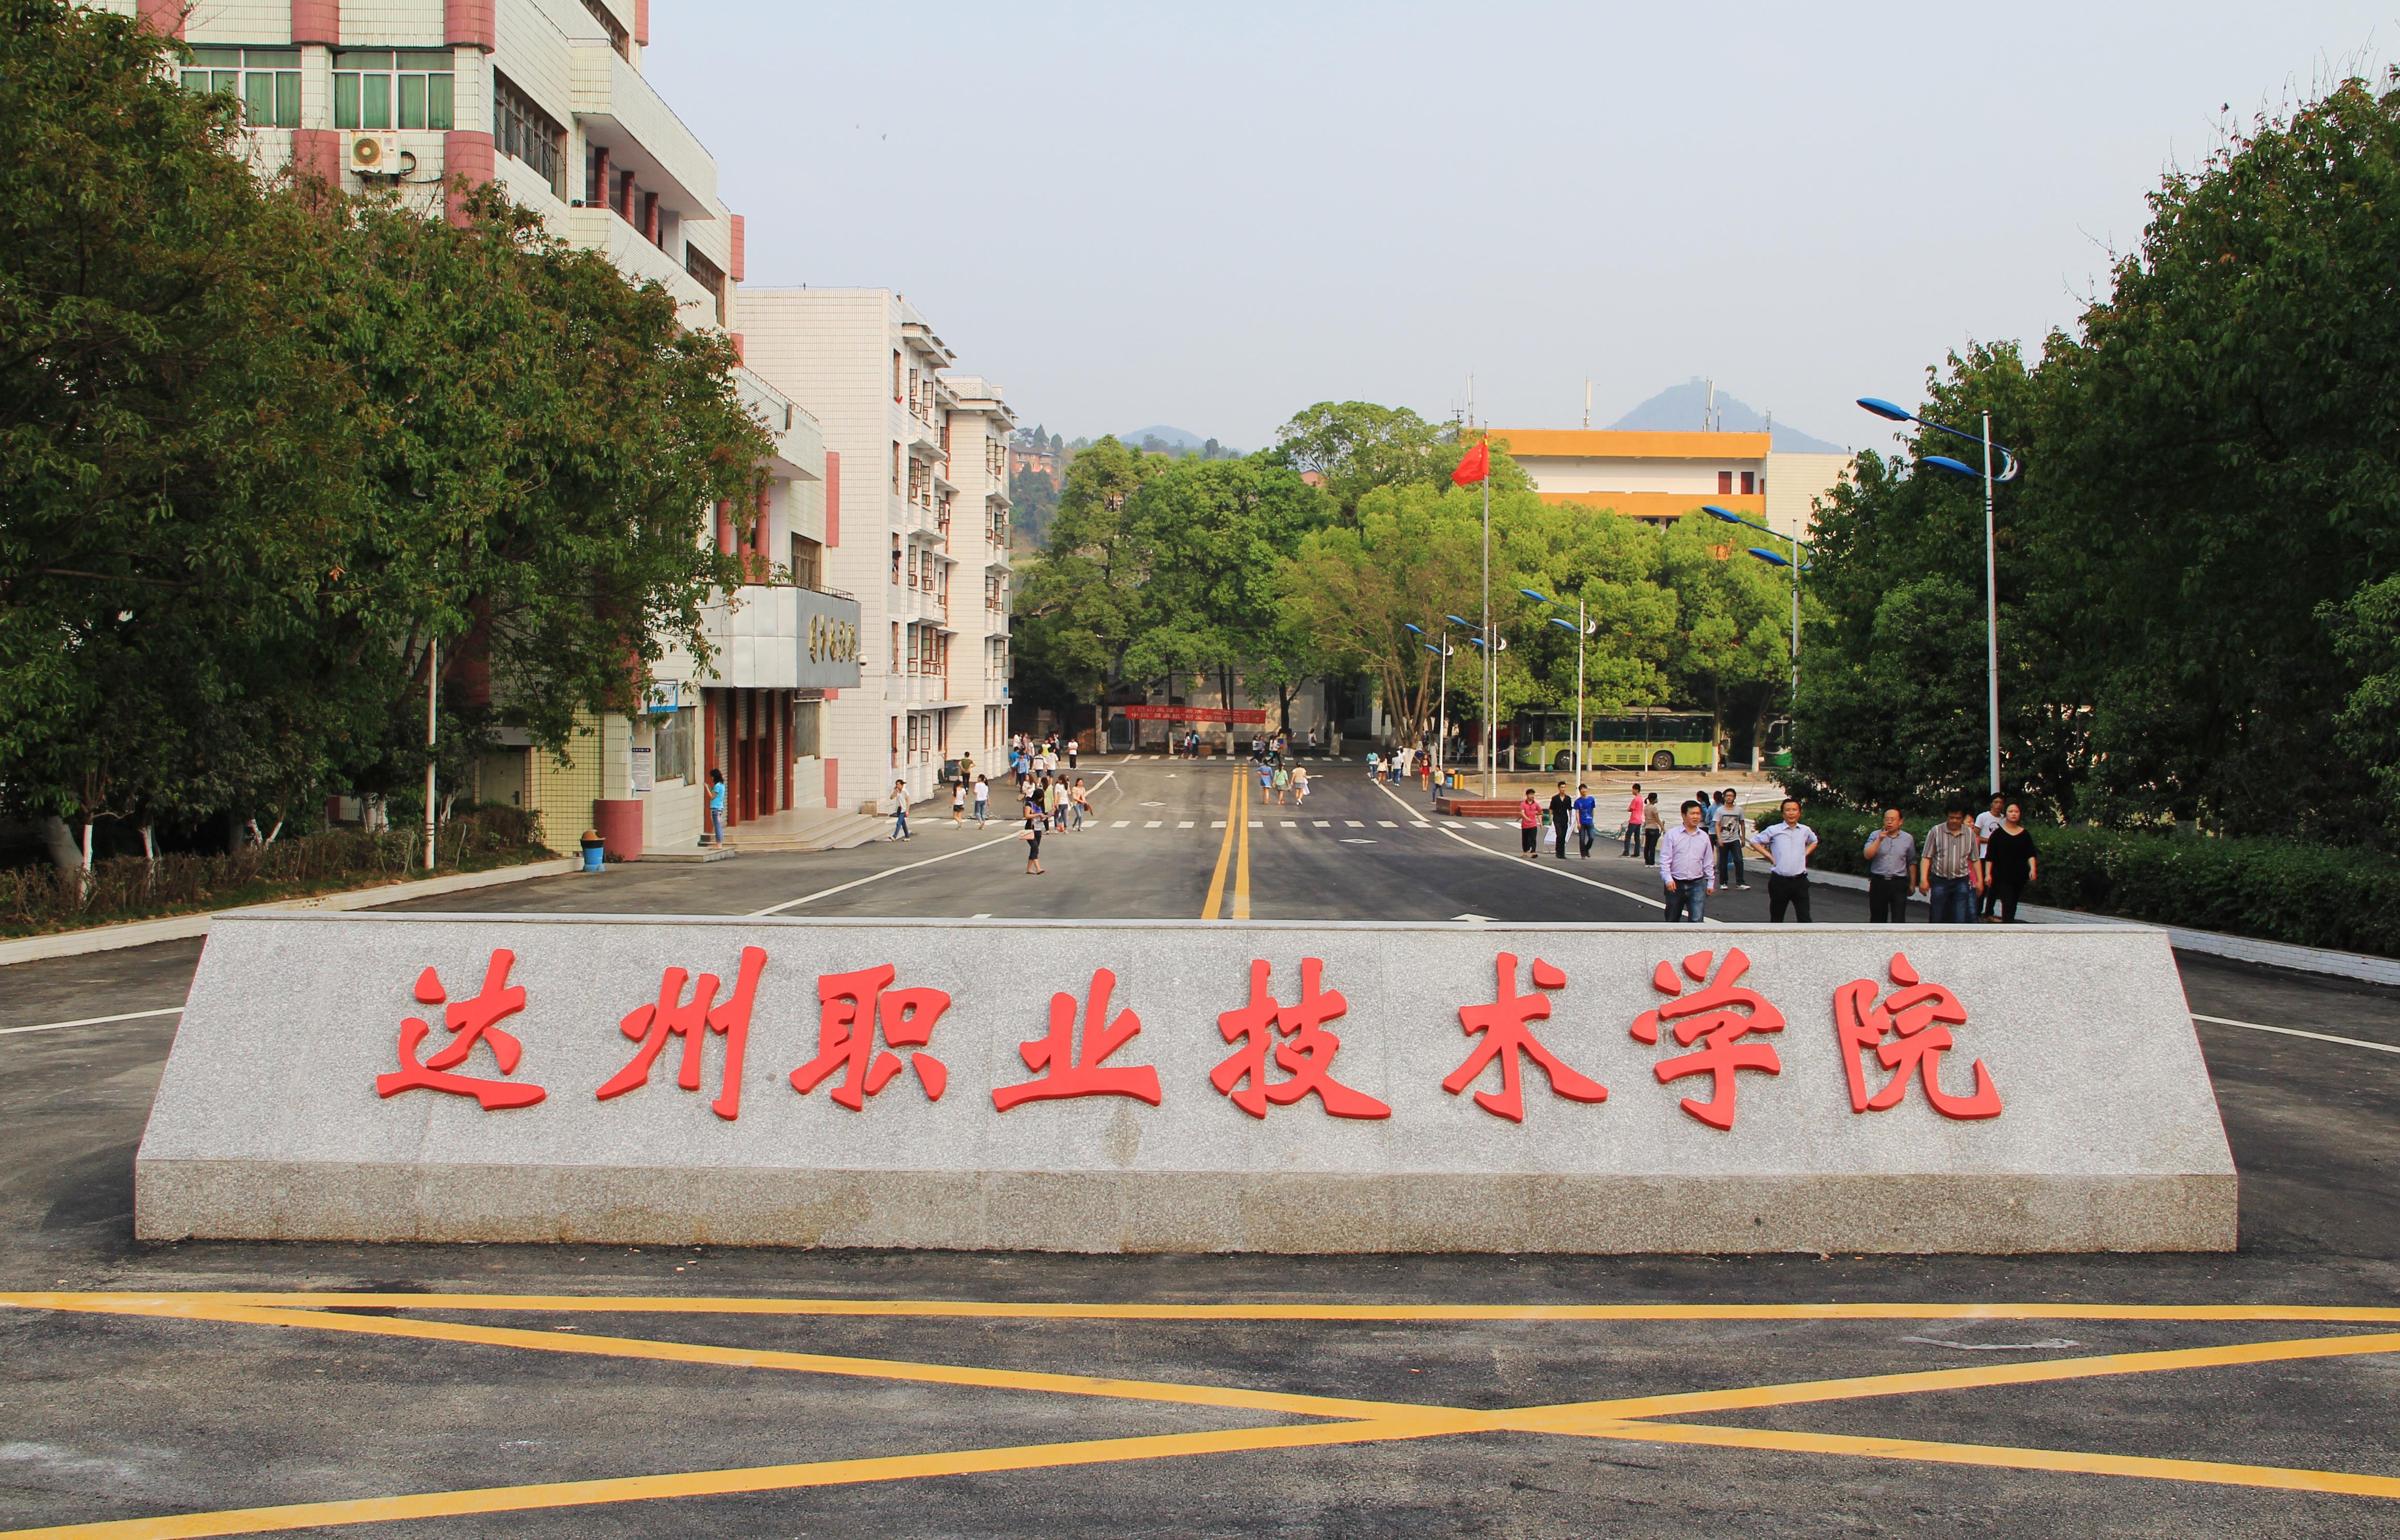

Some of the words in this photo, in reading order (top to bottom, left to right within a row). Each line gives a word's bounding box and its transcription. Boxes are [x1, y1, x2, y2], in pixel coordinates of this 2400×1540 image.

[376, 946, 2004, 1131] 达州职业技术学院
